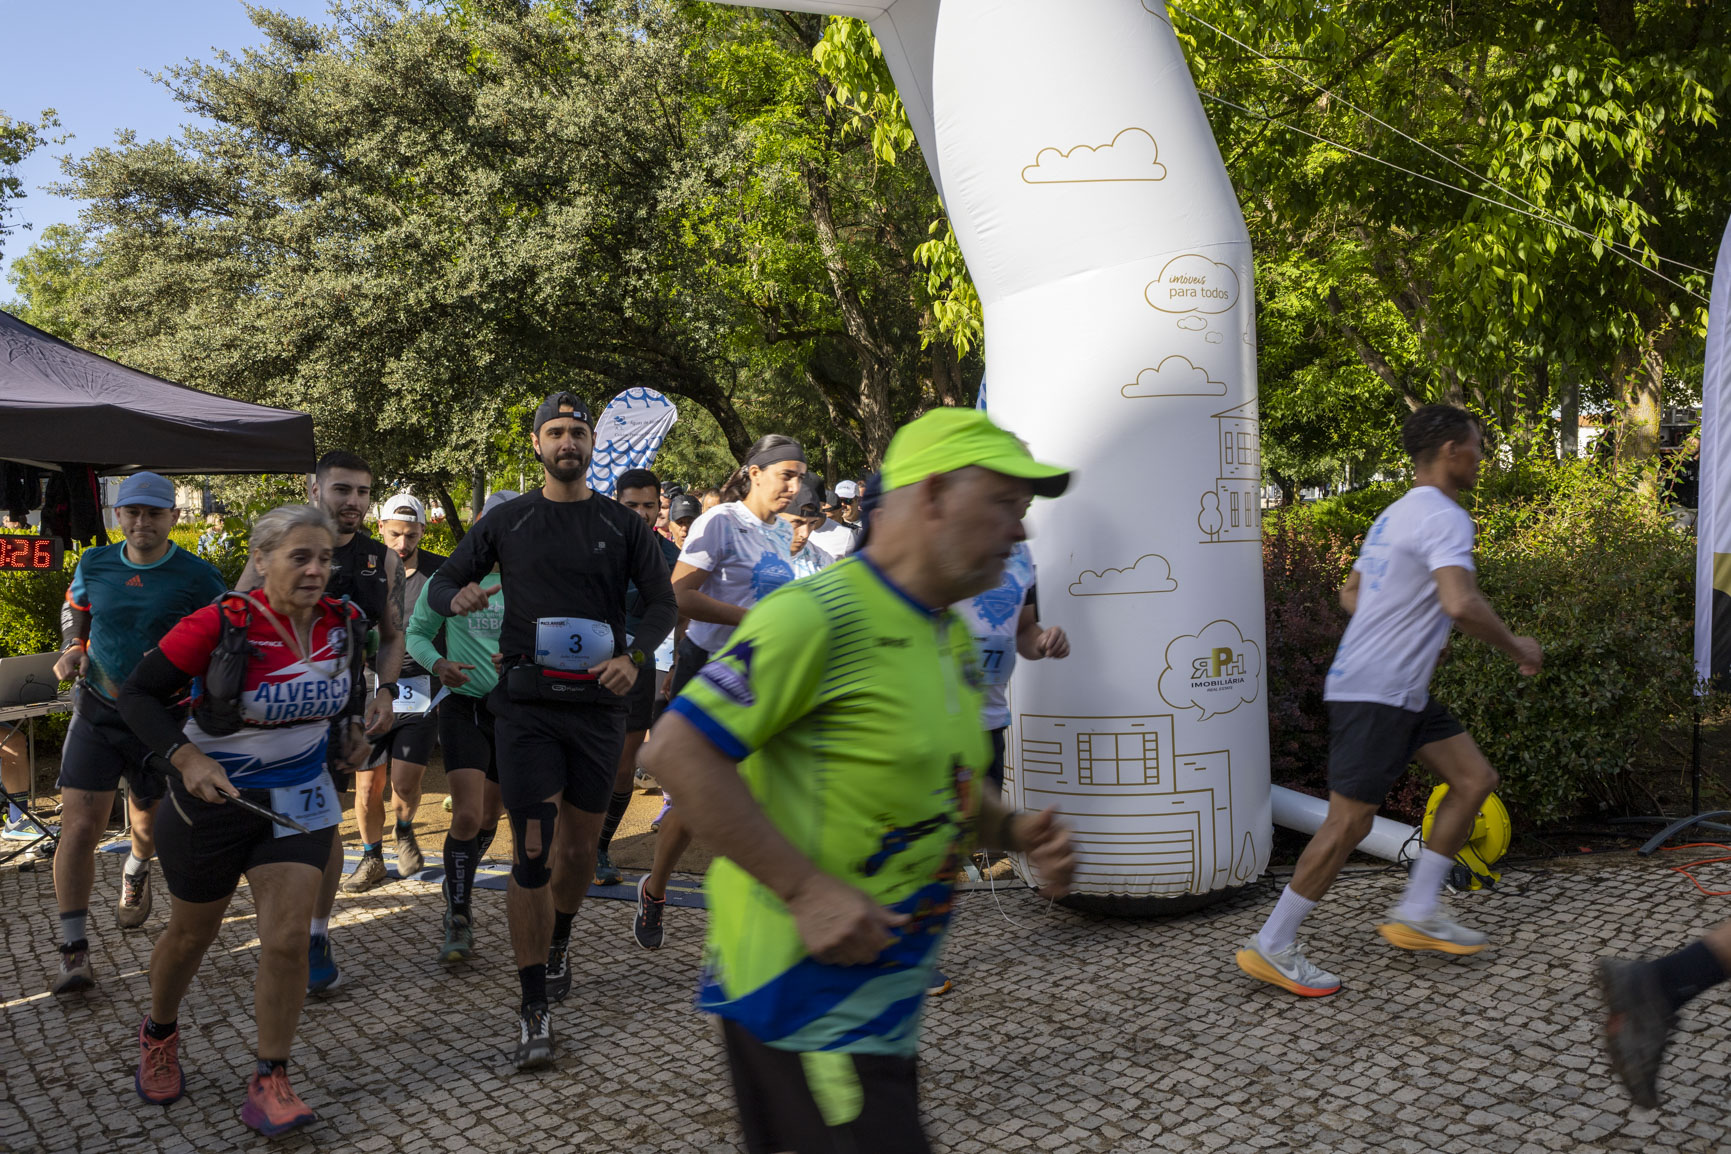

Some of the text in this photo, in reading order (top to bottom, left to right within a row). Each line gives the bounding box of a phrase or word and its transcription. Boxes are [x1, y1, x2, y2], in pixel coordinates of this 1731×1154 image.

[1169, 272, 1206, 285] imóveis
[1169, 288, 1228, 300] para todos
[468, 618, 503, 630] LISB
[568, 634, 582, 654] 3
[982, 650, 1004, 668] 77
[1191, 678, 1244, 688] IMOBILIÁRIA
[264, 700, 343, 720] URBAN
[299, 786, 326, 811] 75
[452, 852, 468, 904] kalenji
